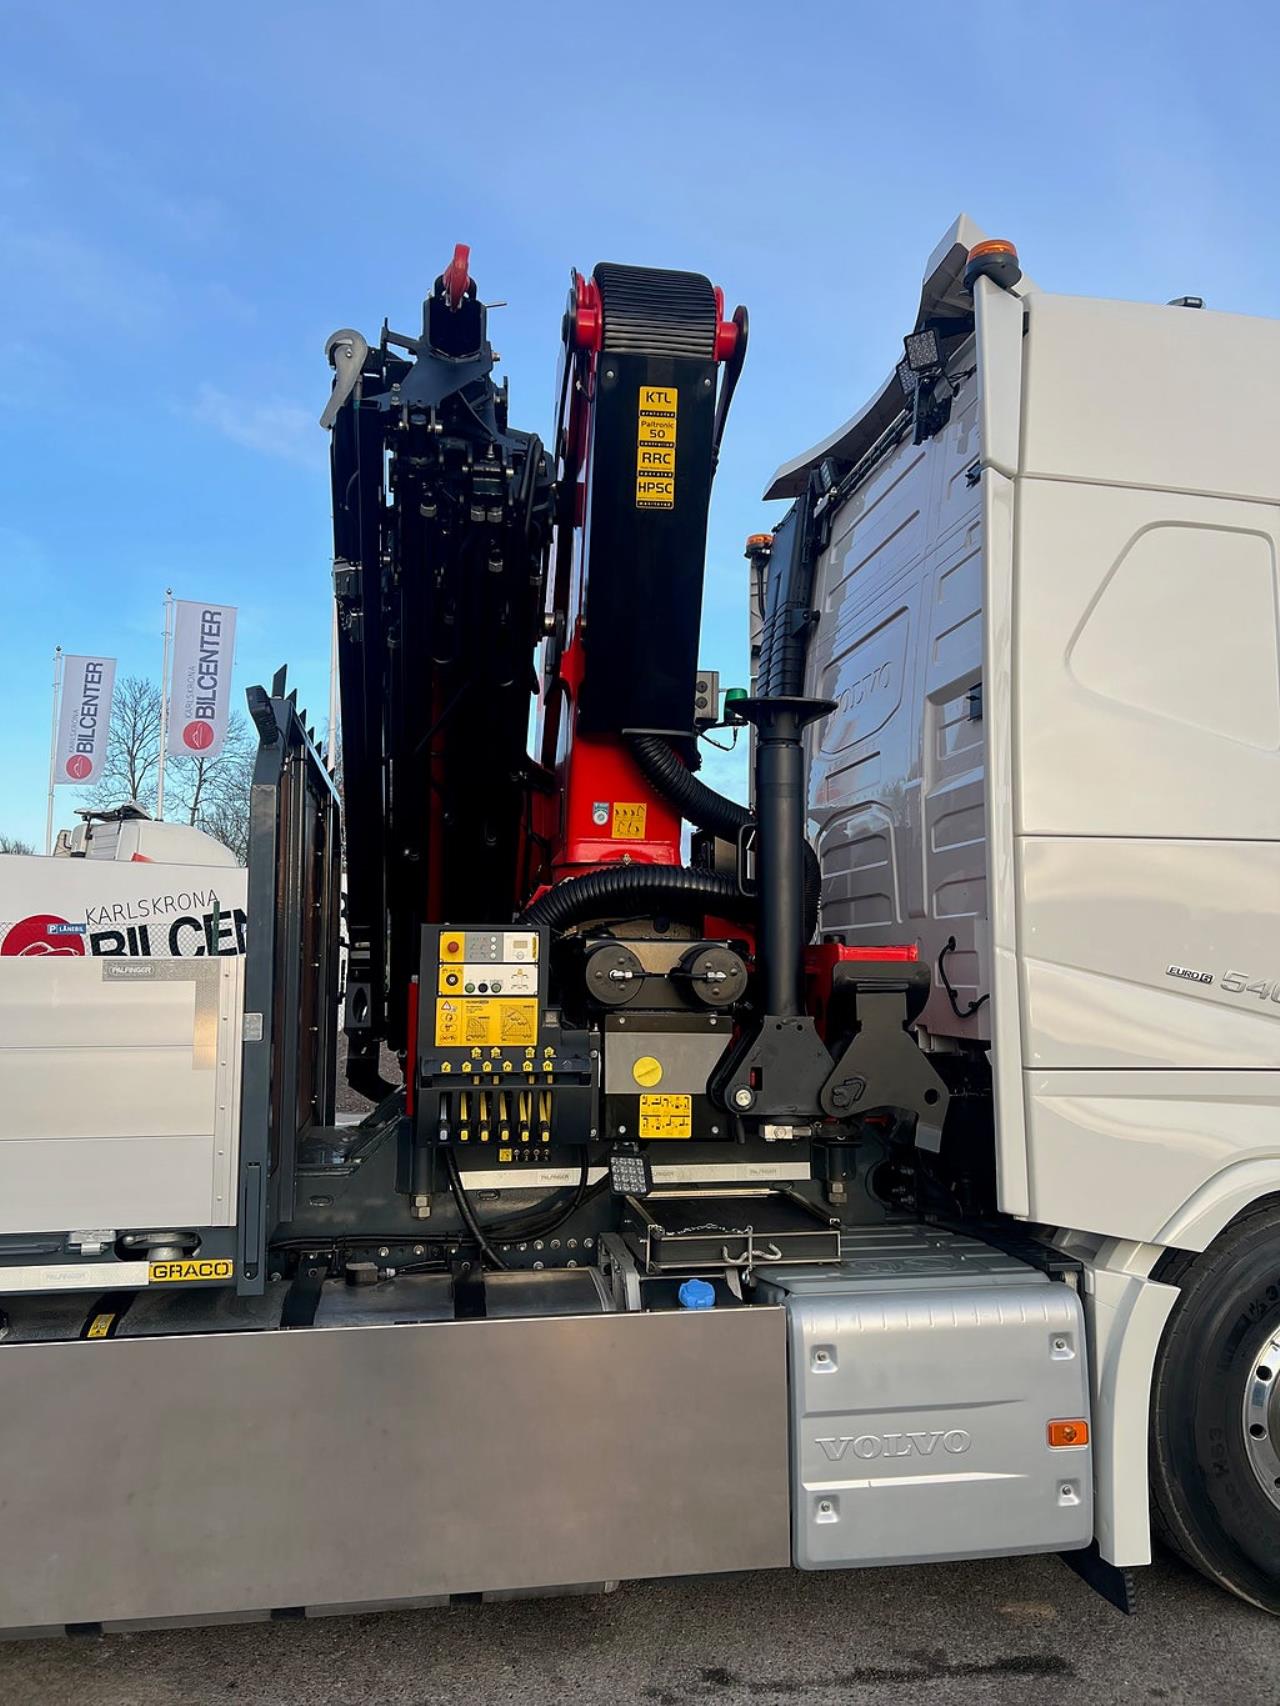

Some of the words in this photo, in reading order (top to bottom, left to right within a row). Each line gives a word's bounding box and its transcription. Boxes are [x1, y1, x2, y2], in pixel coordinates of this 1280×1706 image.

[646, 391, 672, 404] KTL
[649, 429, 666, 439] 50
[642, 452, 672, 465] RRC
[638, 481, 673, 495] HPSC
[195, 609, 222, 720] BILCENTER
[832, 661, 891, 717] OLVO
[76, 661, 104, 754] BILCENTER
[85, 888, 220, 926] KARLSKRONA
[110, 965, 153, 975] PALFINGER
[152, 1261, 230, 1280] GRACO
[814, 1429, 973, 1462] VOLVO
